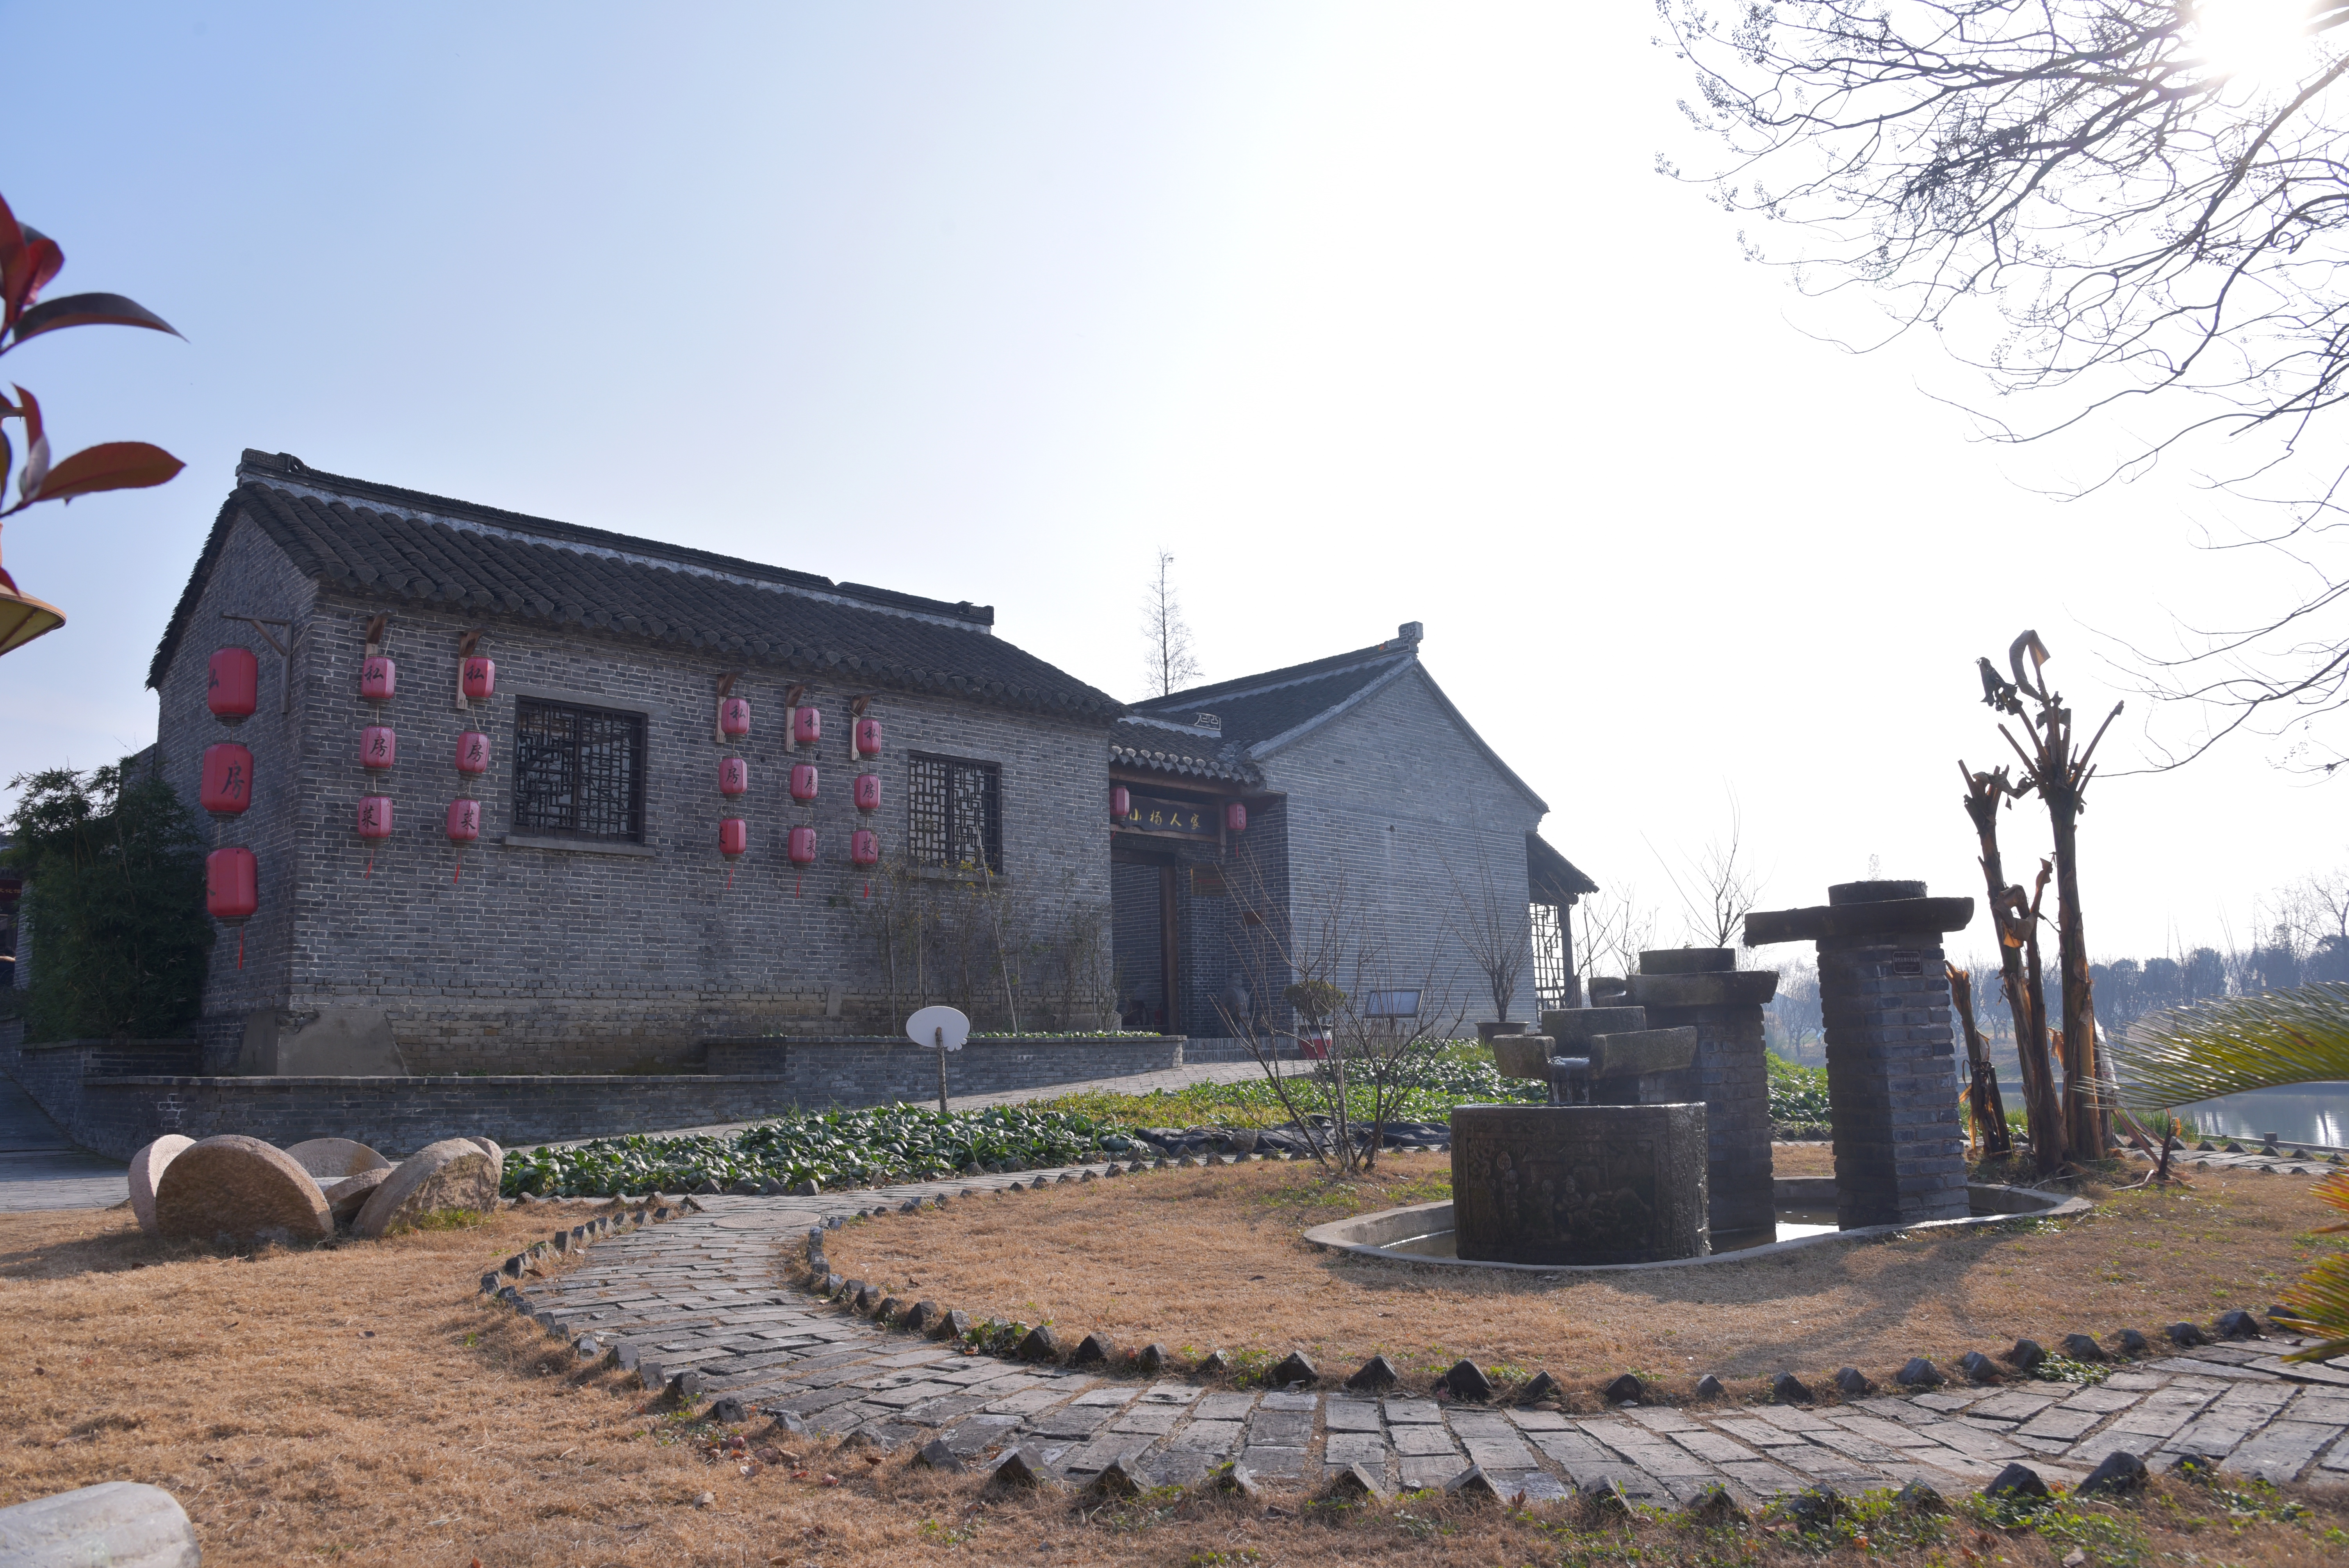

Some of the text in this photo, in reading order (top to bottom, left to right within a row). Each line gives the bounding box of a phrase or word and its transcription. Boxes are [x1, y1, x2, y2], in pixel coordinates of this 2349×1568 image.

[364, 665, 384, 683] 私
[465, 664, 485, 681] 私
[729, 705, 746, 720] 私
[804, 713, 819, 729] 私
[863, 726, 879, 741] 私
[369, 735, 387, 757] 房
[467, 741, 483, 763] 房
[220, 761, 245, 800] 房
[725, 766, 740, 784] 房
[805, 772, 816, 791] 房
[863, 780, 875, 798] 房
[361, 805, 378, 829] 菜
[460, 810, 476, 830] 菜
[1130, 808, 1201, 830] 小杨人家
[806, 836, 815, 854] 菜
[861, 838, 875, 855] 菜
